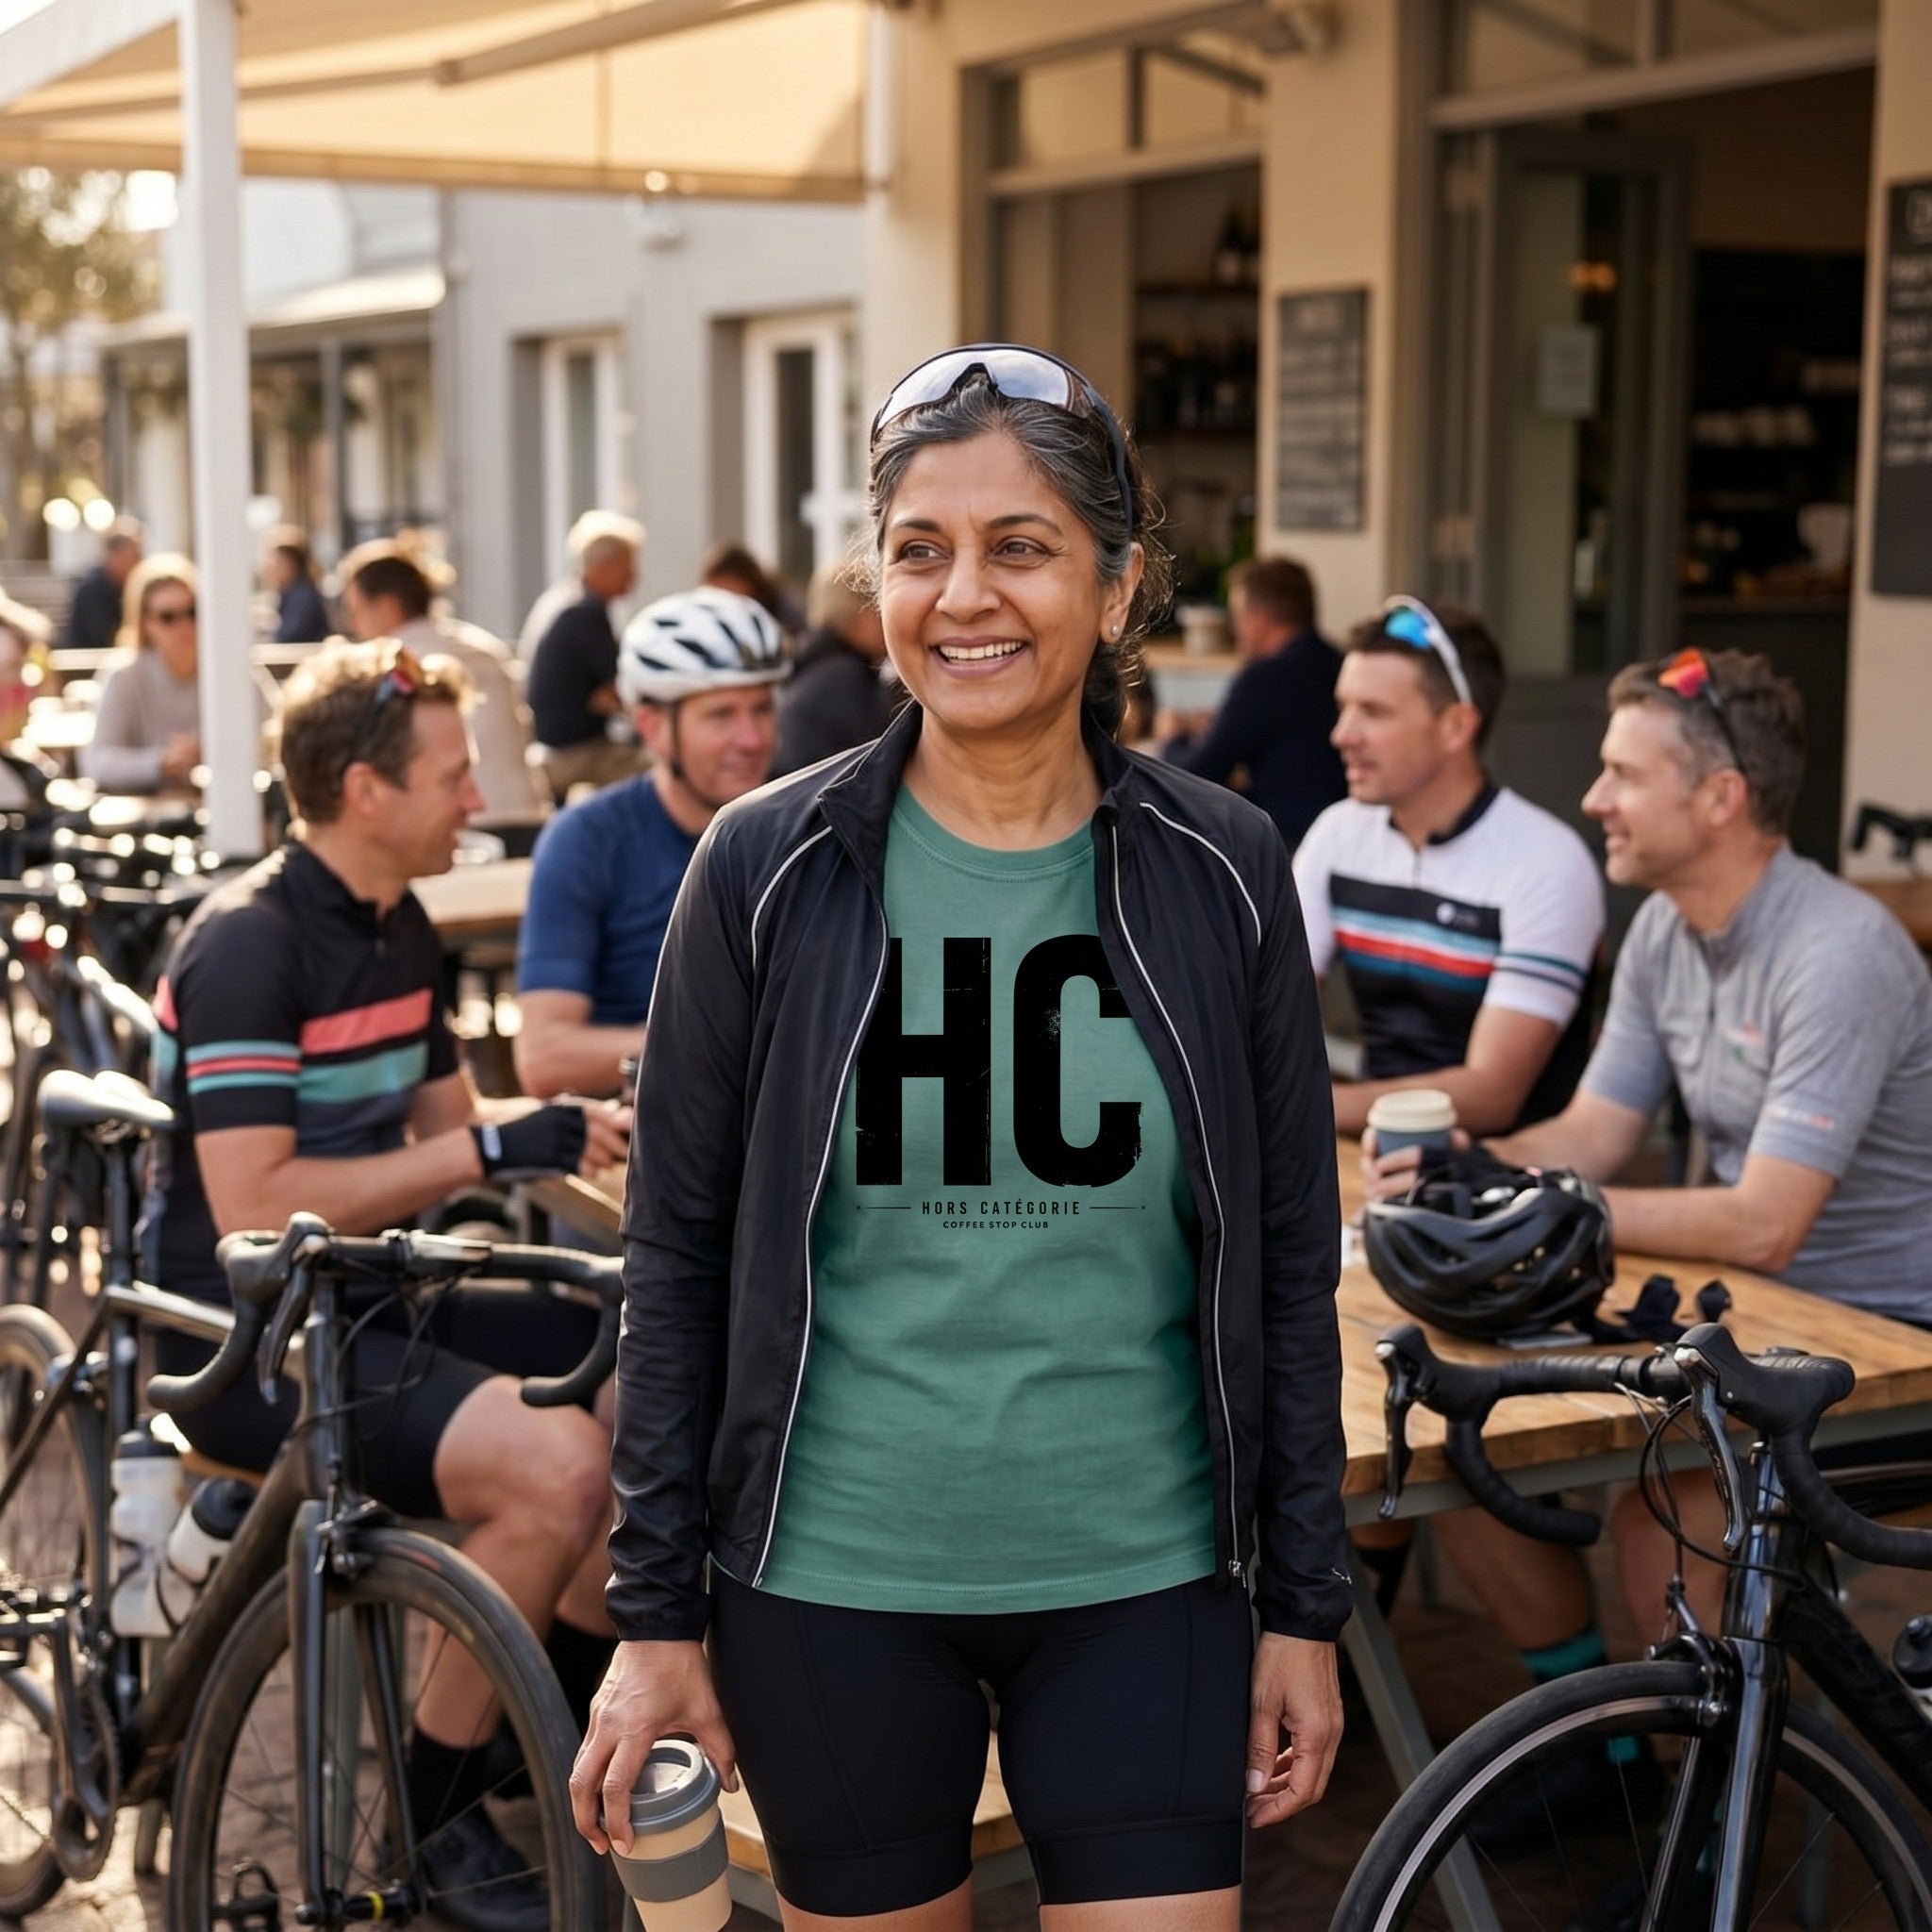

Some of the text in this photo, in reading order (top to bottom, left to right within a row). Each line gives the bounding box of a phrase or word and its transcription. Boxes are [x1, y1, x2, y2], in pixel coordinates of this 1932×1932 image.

[856, 934, 1141, 1188] HC
[922, 1198, 1080, 1215] HORS CATÉGORIE
[942, 1221, 1049, 1229] COFFEE STOP CLUB
